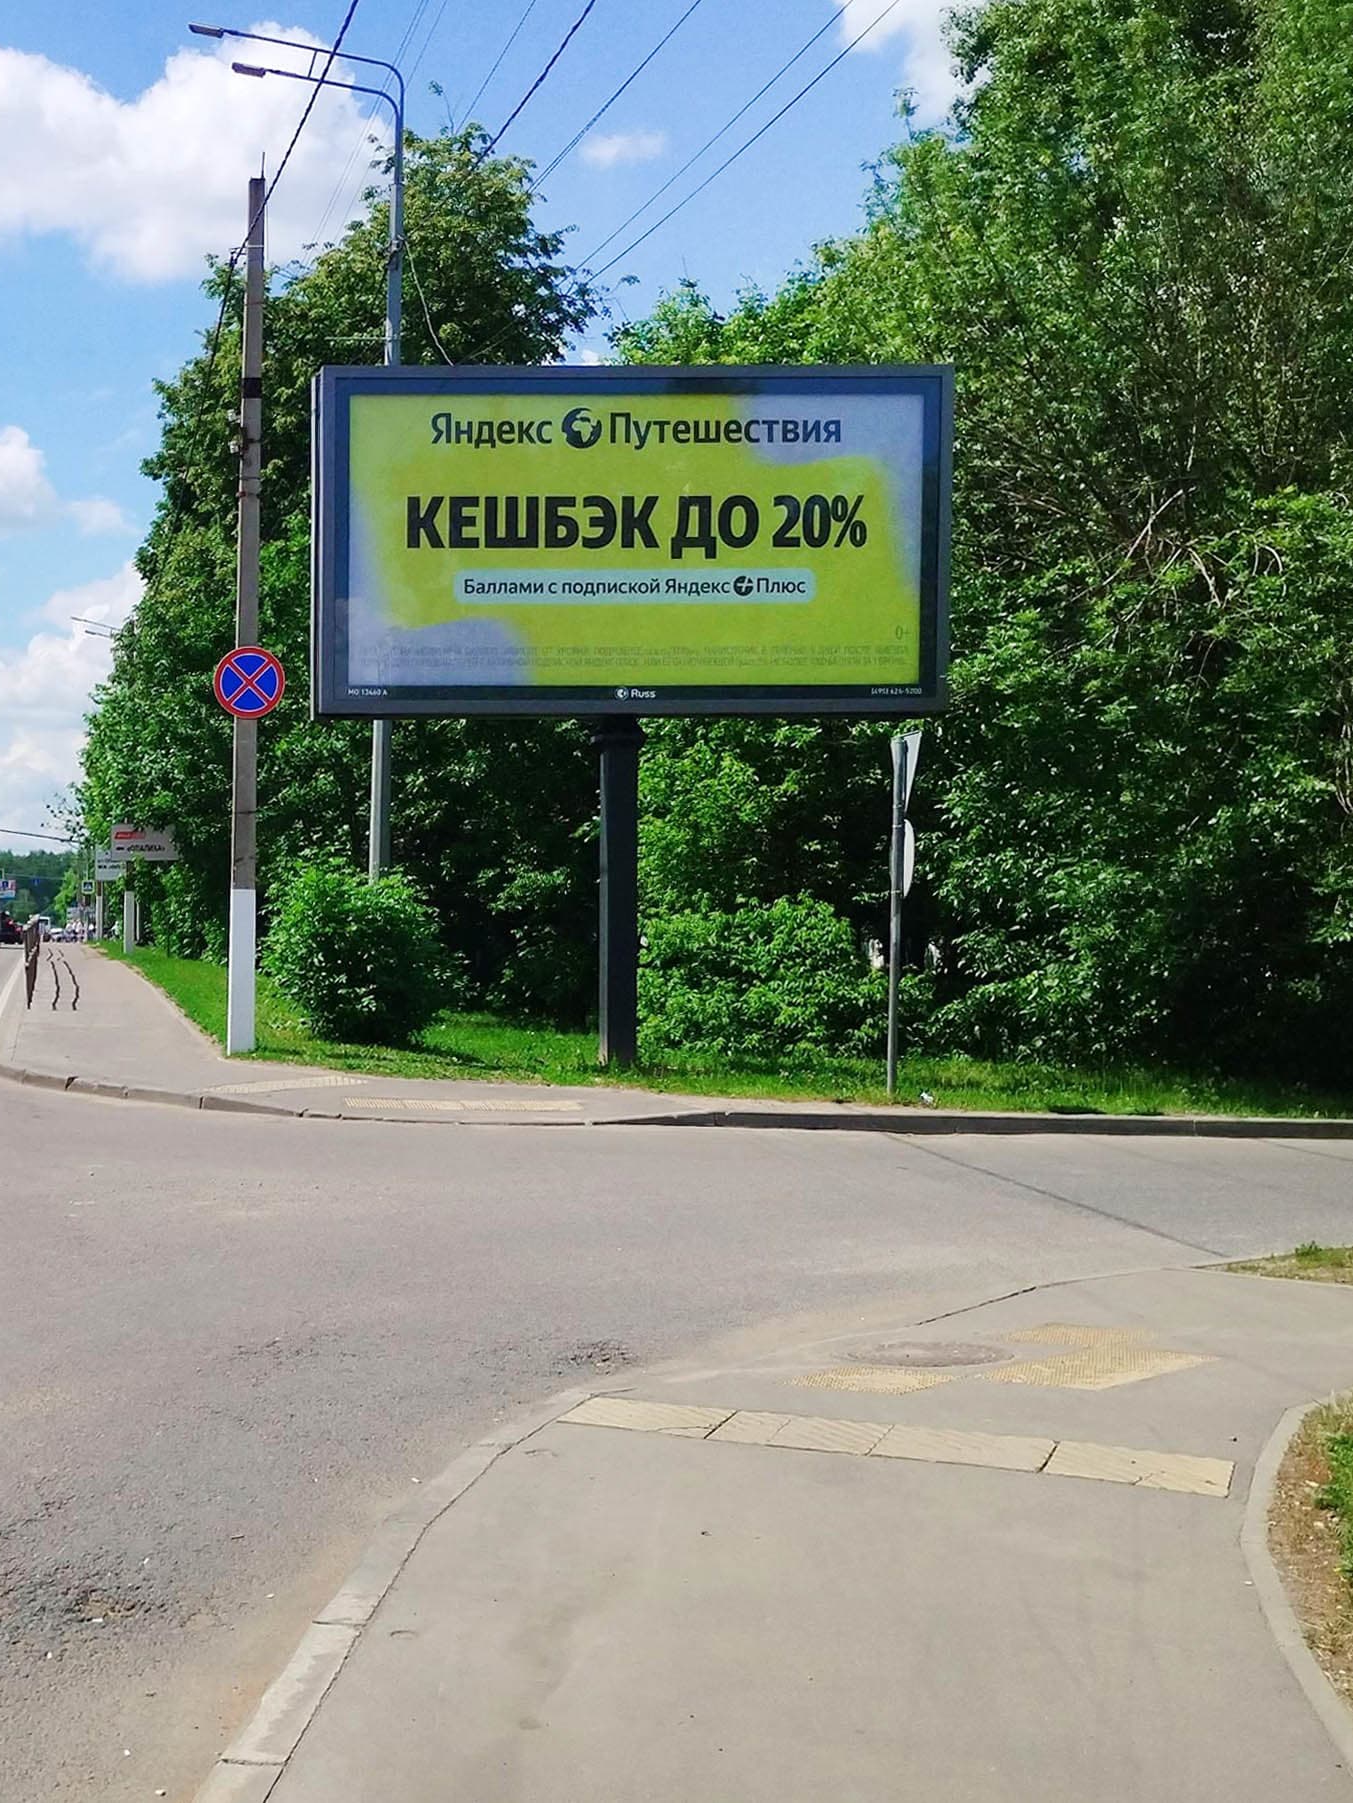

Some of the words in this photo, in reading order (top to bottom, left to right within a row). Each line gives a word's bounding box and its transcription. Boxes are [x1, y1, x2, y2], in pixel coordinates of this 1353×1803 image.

[431, 412, 552, 449] Яндекс
[610, 412, 842, 450] Путешествия
[406, 495, 660, 549] КЕШБЭК
[671, 495, 760, 560] ДО
[771, 494, 868, 549] 20%
[463, 578, 544, 594] Баллами
[548, 581, 558, 594] с
[562, 578, 661, 596] подпиской
[664, 578, 732, 597] Яндекс
[756, 577, 807, 594] Плюс
[630, 688, 657, 699] Russ
